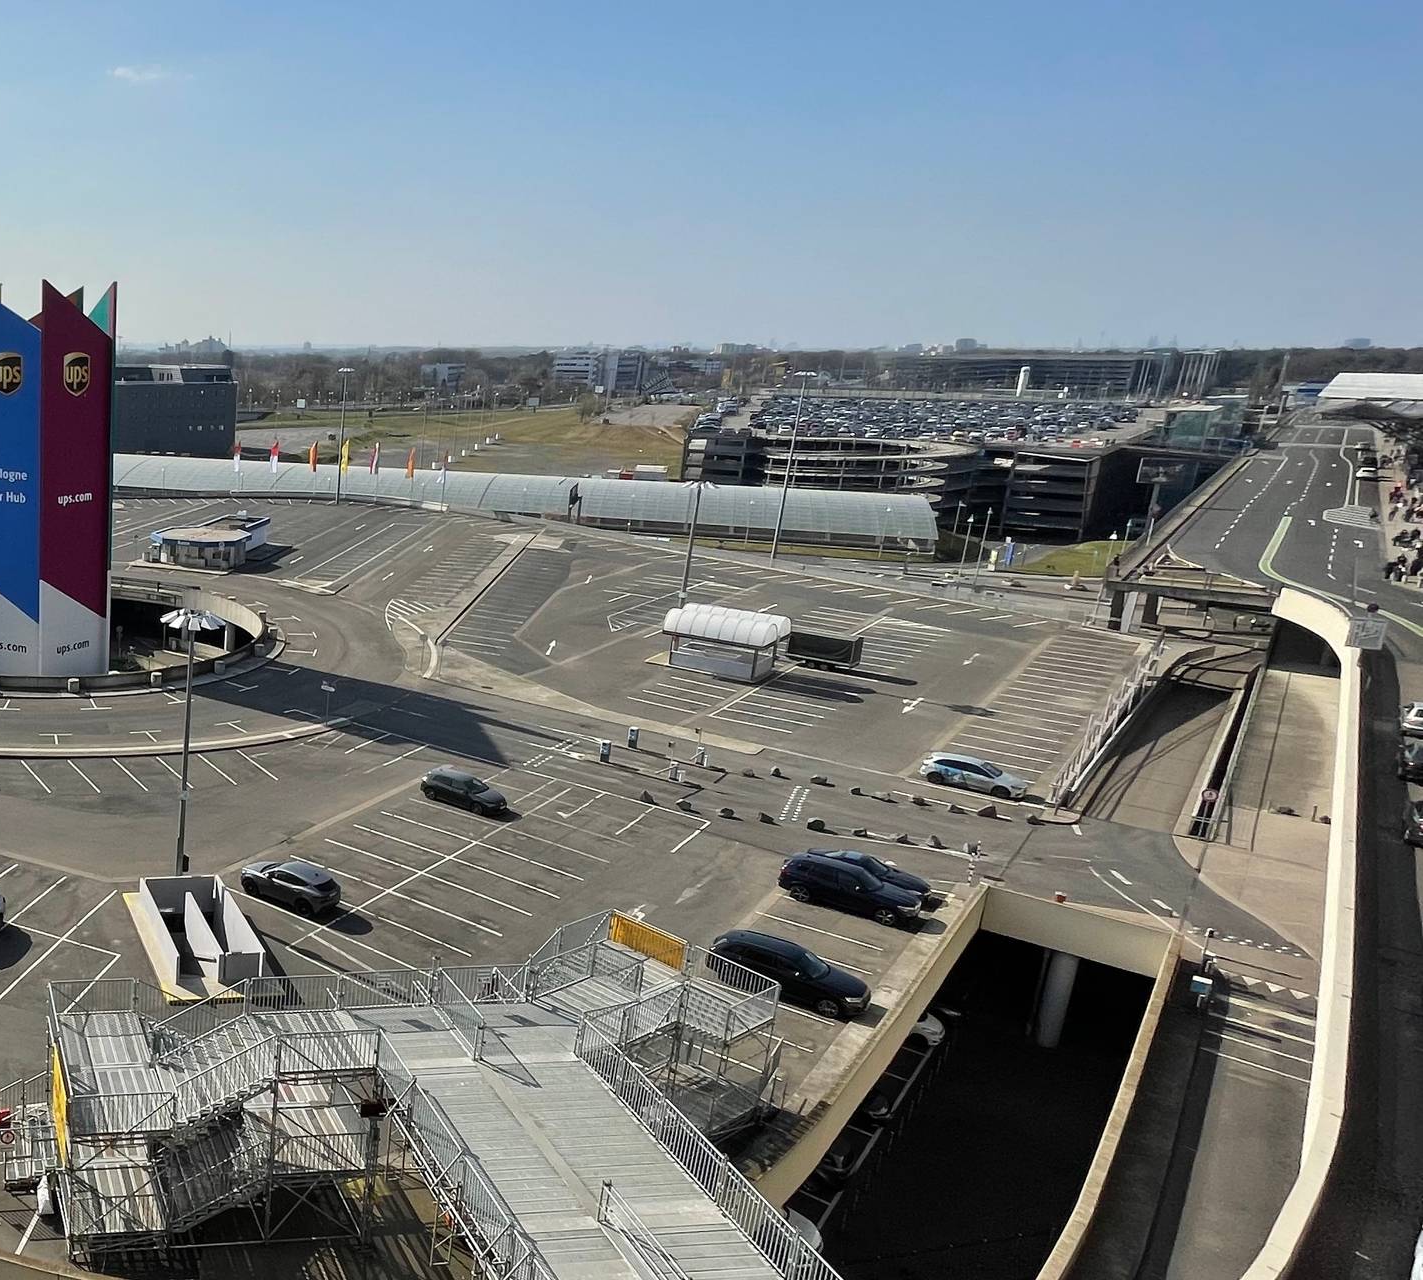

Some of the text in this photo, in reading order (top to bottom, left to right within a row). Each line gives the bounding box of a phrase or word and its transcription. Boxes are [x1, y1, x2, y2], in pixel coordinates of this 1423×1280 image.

[65, 365, 89, 390] ups
[6, 491, 26, 504] Hub
[57, 492, 93, 507] ups.com
[56, 640, 90, 656] ups.com
